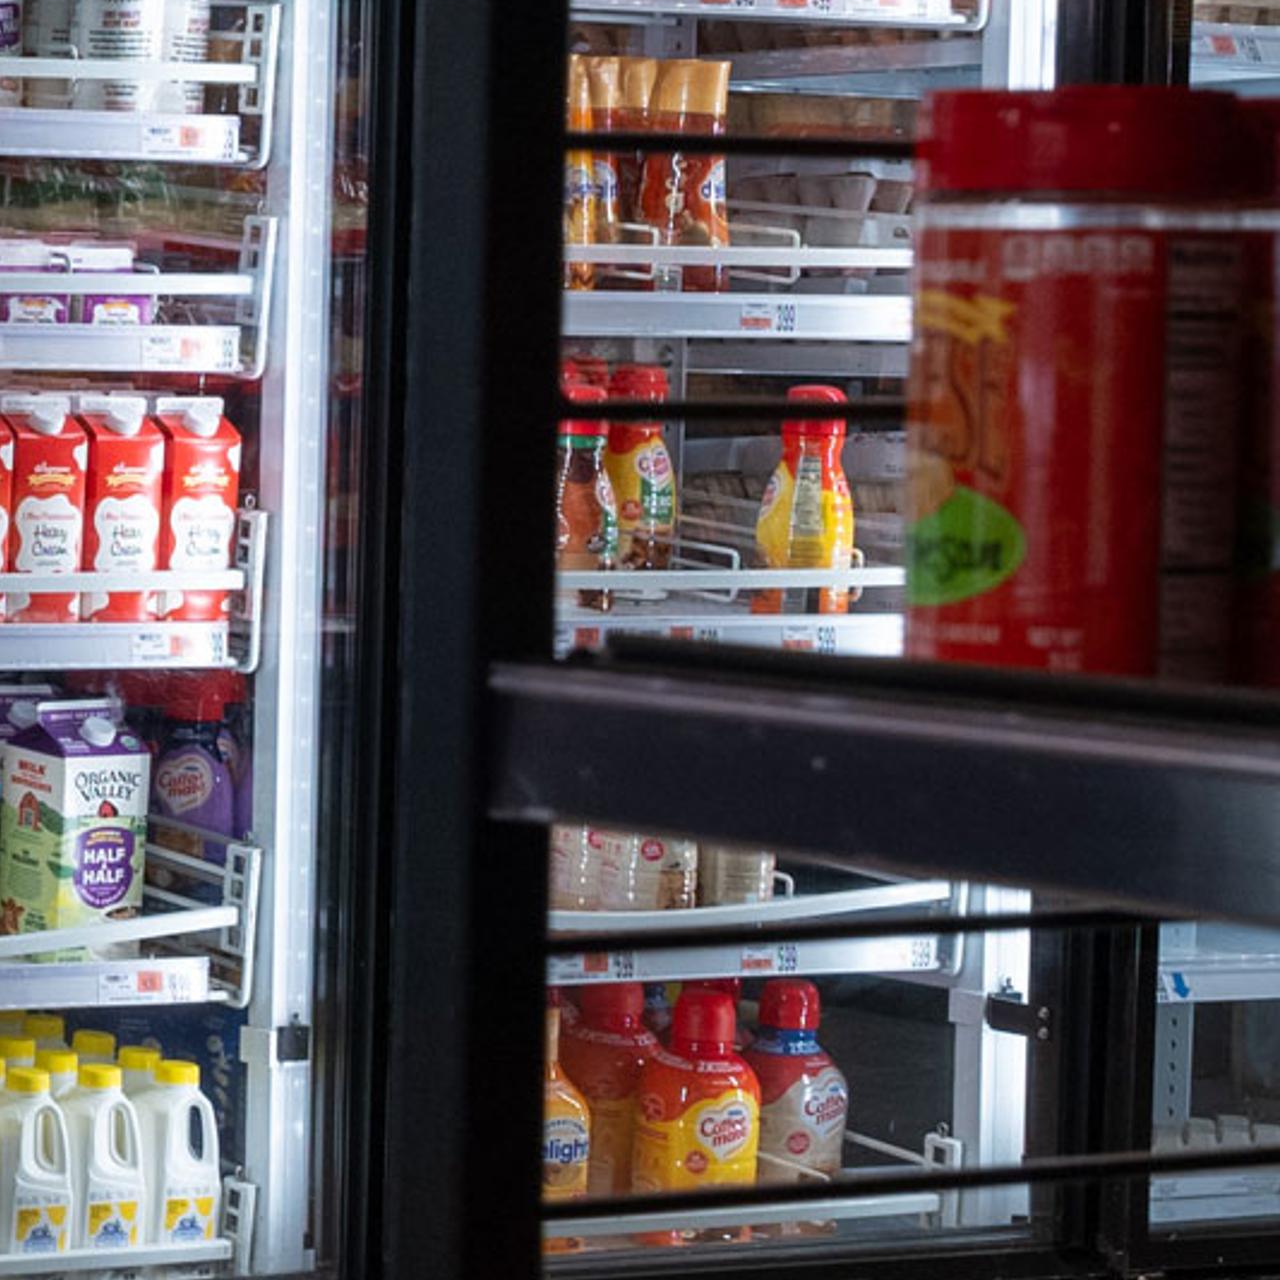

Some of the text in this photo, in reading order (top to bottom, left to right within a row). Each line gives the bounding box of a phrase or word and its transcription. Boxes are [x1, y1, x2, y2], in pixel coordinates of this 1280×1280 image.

[33, 523, 68, 543] Heavy
[32, 540, 68, 557] Cream
[18, 760, 46, 776] MILK
[75, 770, 142, 790] ORGANIC
[80, 786, 136, 802] VALLEY
[83, 847, 126, 864] HALF
[82, 868, 125, 886] HALF
[804, 1091, 847, 1117] Coffee
[700, 1116, 747, 1138] Coffee
[712, 1127, 749, 1148] mate
[545, 1138, 589, 1165] elight
